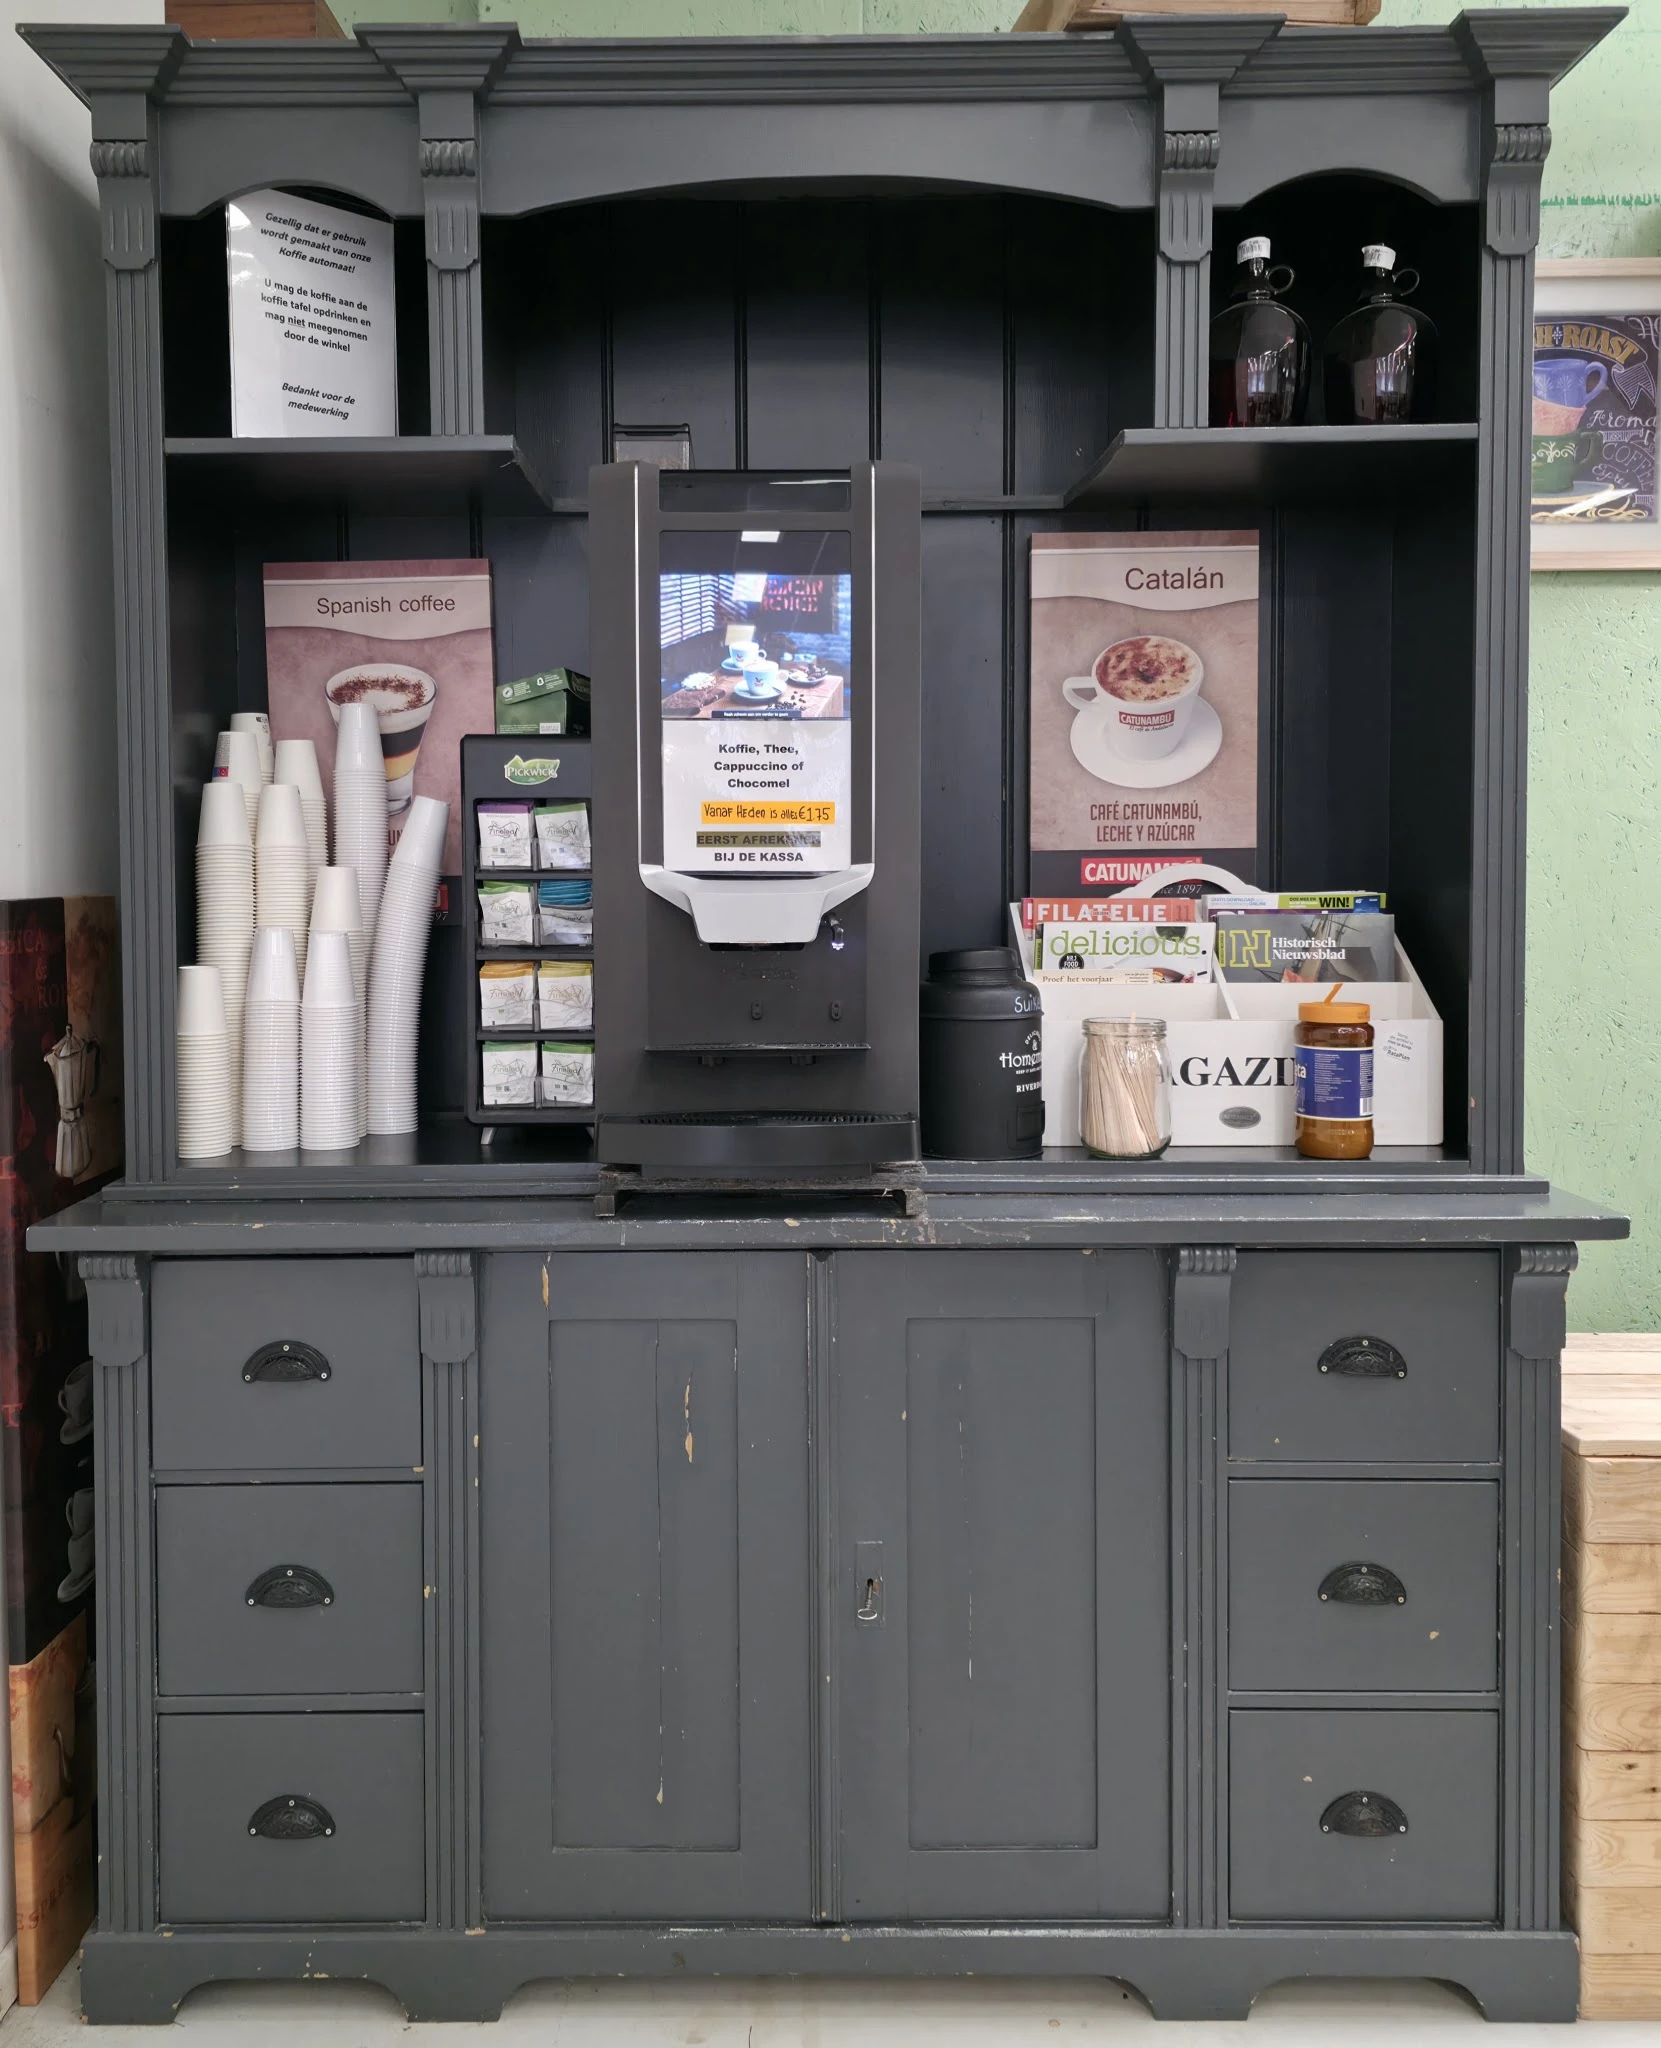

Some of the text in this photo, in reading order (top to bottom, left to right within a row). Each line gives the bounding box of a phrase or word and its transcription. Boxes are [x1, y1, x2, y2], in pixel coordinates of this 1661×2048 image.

[265, 212, 367, 247] Gezellig dat er gebruik
[260, 228, 372, 263] wordt gemaakt van onze
[279, 247, 356, 273] Koffie automaat!
[264, 278, 368, 311] U mag de koffie aan de
[260, 293, 371, 327] koffie tafel opdrinken en
[264, 311, 368, 341] mag niet meegenomen
[284, 329, 351, 352] door de winkel
[1562, 324, 1640, 365] ROAST
[281, 382, 356, 405] Bedankt voor de
[287, 400, 349, 421] medewerking
[1125, 566, 1224, 591] Catalán
[317, 595, 455, 618] Spanish coffee
[718, 744, 799, 755] Koffie, Thee,
[507, 768, 555, 777] PICKWICK
[713, 761, 804, 773] Cappuccino of
[727, 778, 790, 788] Chocomel
[1090, 800, 1202, 822] CAFÉ CATUNAMBÚ,
[697, 835, 821, 845] EERST AFREKN
[1097, 822, 1195, 842] LECHE Y AZÚCAR
[714, 852, 804, 862] BIJ DE KASSA
[1084, 860, 1195, 882] CATUNA
[1176, 884, 1203, 895] 1897
[1037, 903, 1167, 921] FILATELIE
[1319, 897, 1350, 908] WIN!
[1272, 937, 1336, 948] Historisch
[1272, 948, 1346, 960] Nieuwsblad
[1042, 975, 1113, 984] Proef het voorjaar
[1014, 993, 1041, 1013] Suike
[999, 1052, 1042, 1068] Homem
[1172, 1056, 1295, 1087] GAZI
